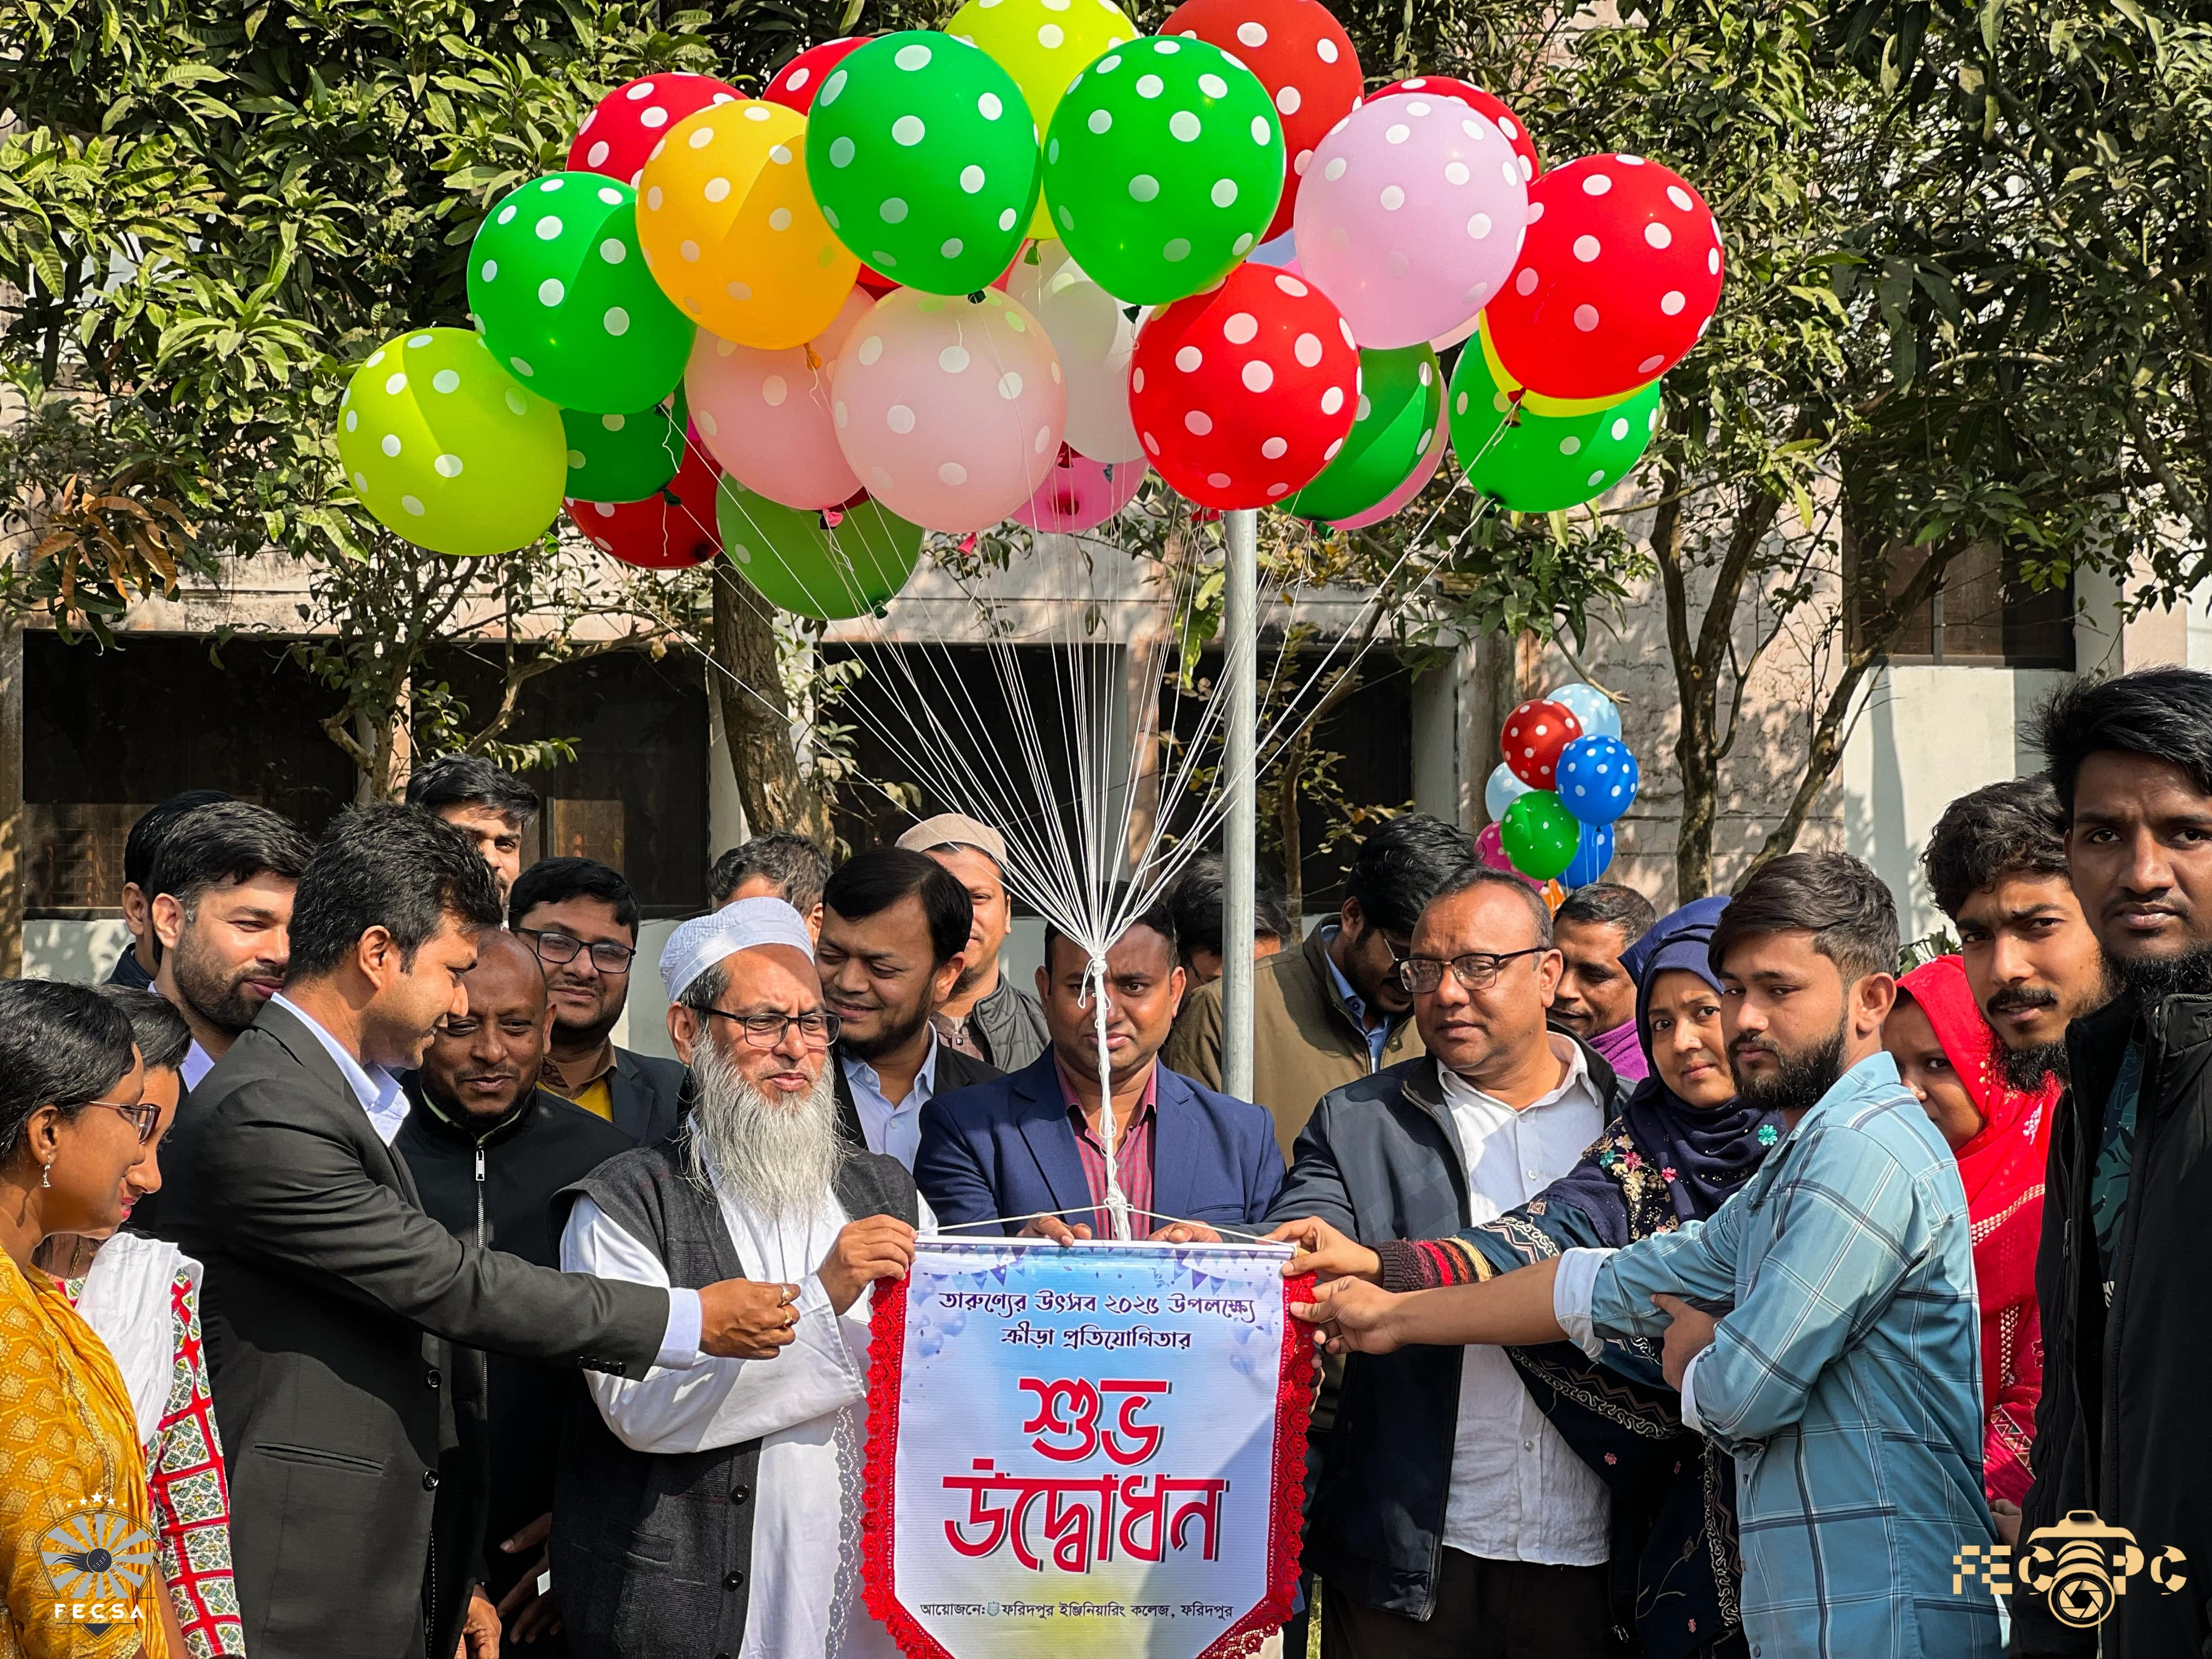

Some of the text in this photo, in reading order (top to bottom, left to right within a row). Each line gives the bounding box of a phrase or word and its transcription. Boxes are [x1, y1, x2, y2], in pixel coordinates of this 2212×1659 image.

[938, 1290, 1256, 1323] তারুণ্যের উৎসব ২০২৫ উপলক্ষ্যে
[1001, 1321, 1192, 1350] ক্রীড়া প্রতিযোগিতার
[1019, 1376, 1171, 1466] শুভ
[942, 1458, 1230, 1573] উদ্বোধন
[920, 1602, 986, 1616] আয়োজনে:
[1001, 1601, 1054, 1620] ফরিদপুর
[1059, 1601, 1125, 1617] ইঞ্জিনিয়ারিং
[1181, 1601, 1234, 1620] ফরিদপুর
